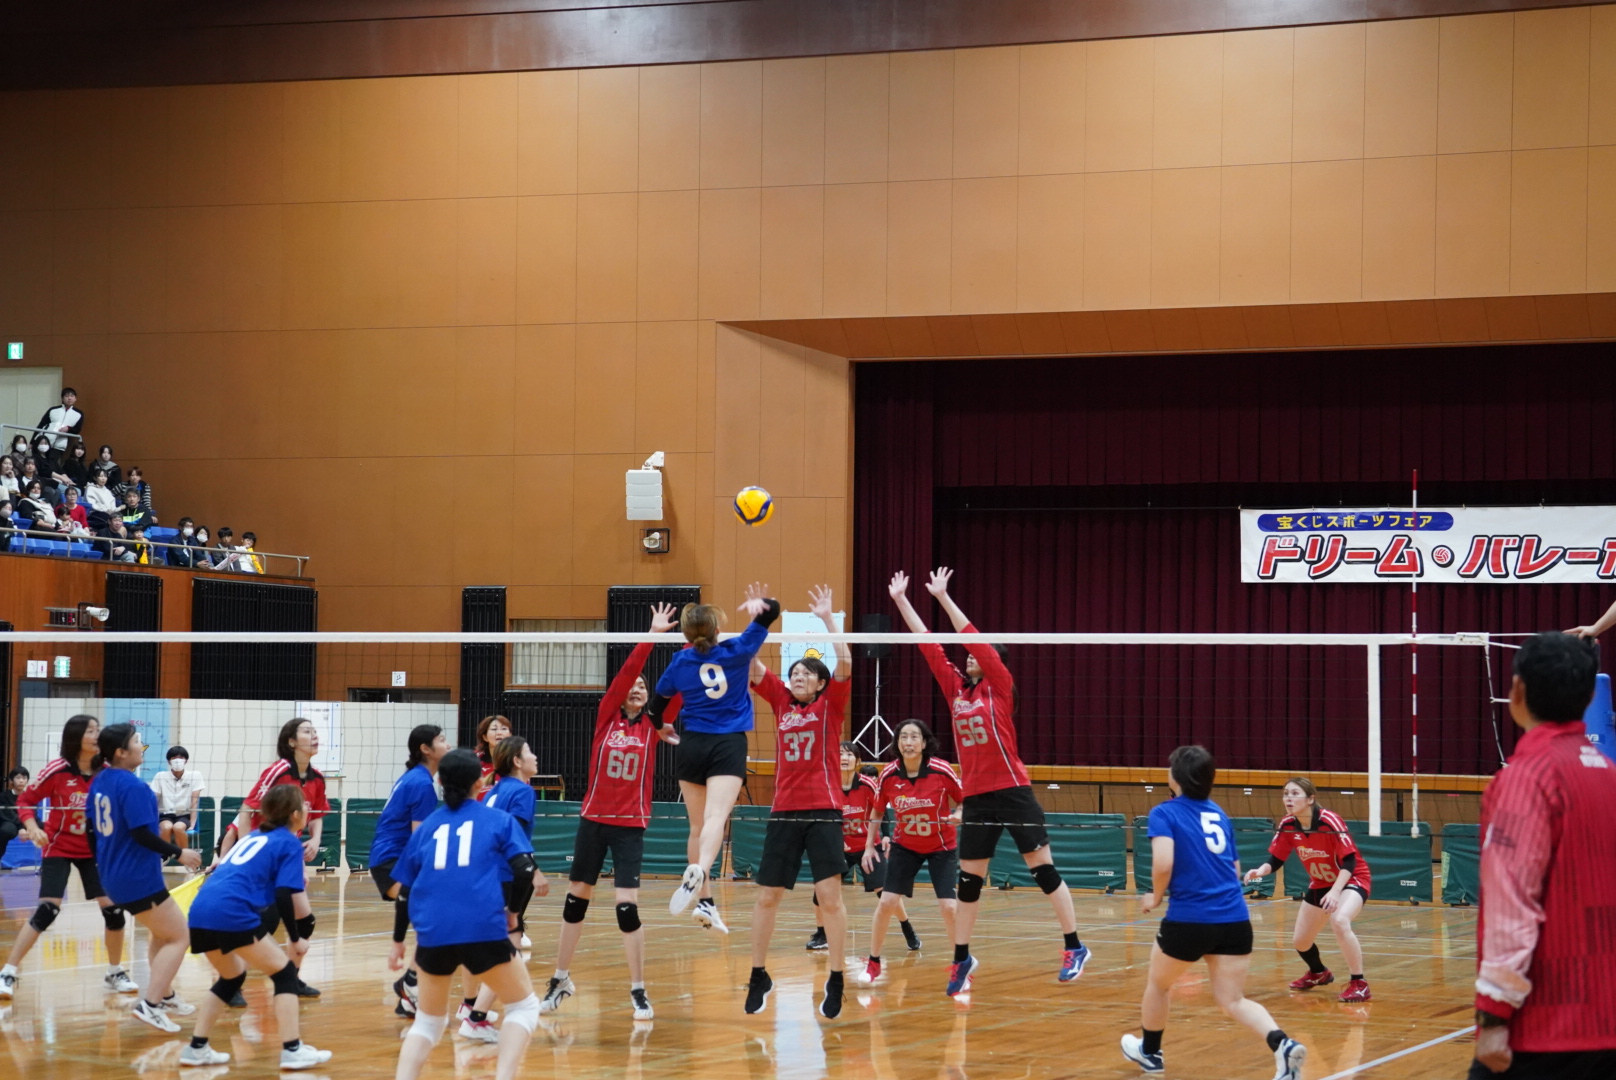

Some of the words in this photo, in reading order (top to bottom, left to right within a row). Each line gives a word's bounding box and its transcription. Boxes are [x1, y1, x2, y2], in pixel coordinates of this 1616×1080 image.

[1276, 514, 1432, 530] 宝くじスポーツフェア
[1258, 535, 1423, 580] ドリーム
[699, 663, 728, 700] 9
[784, 730, 816, 762] 37
[955, 715, 988, 747] 56
[606, 749, 640, 781] 60
[94, 792, 114, 837] 13
[902, 813, 932, 836] 26
[433, 820, 474, 870] 11
[1200, 811, 1227, 854] 5
[221, 834, 269, 866] 10
[1309, 862, 1337, 883] 46
